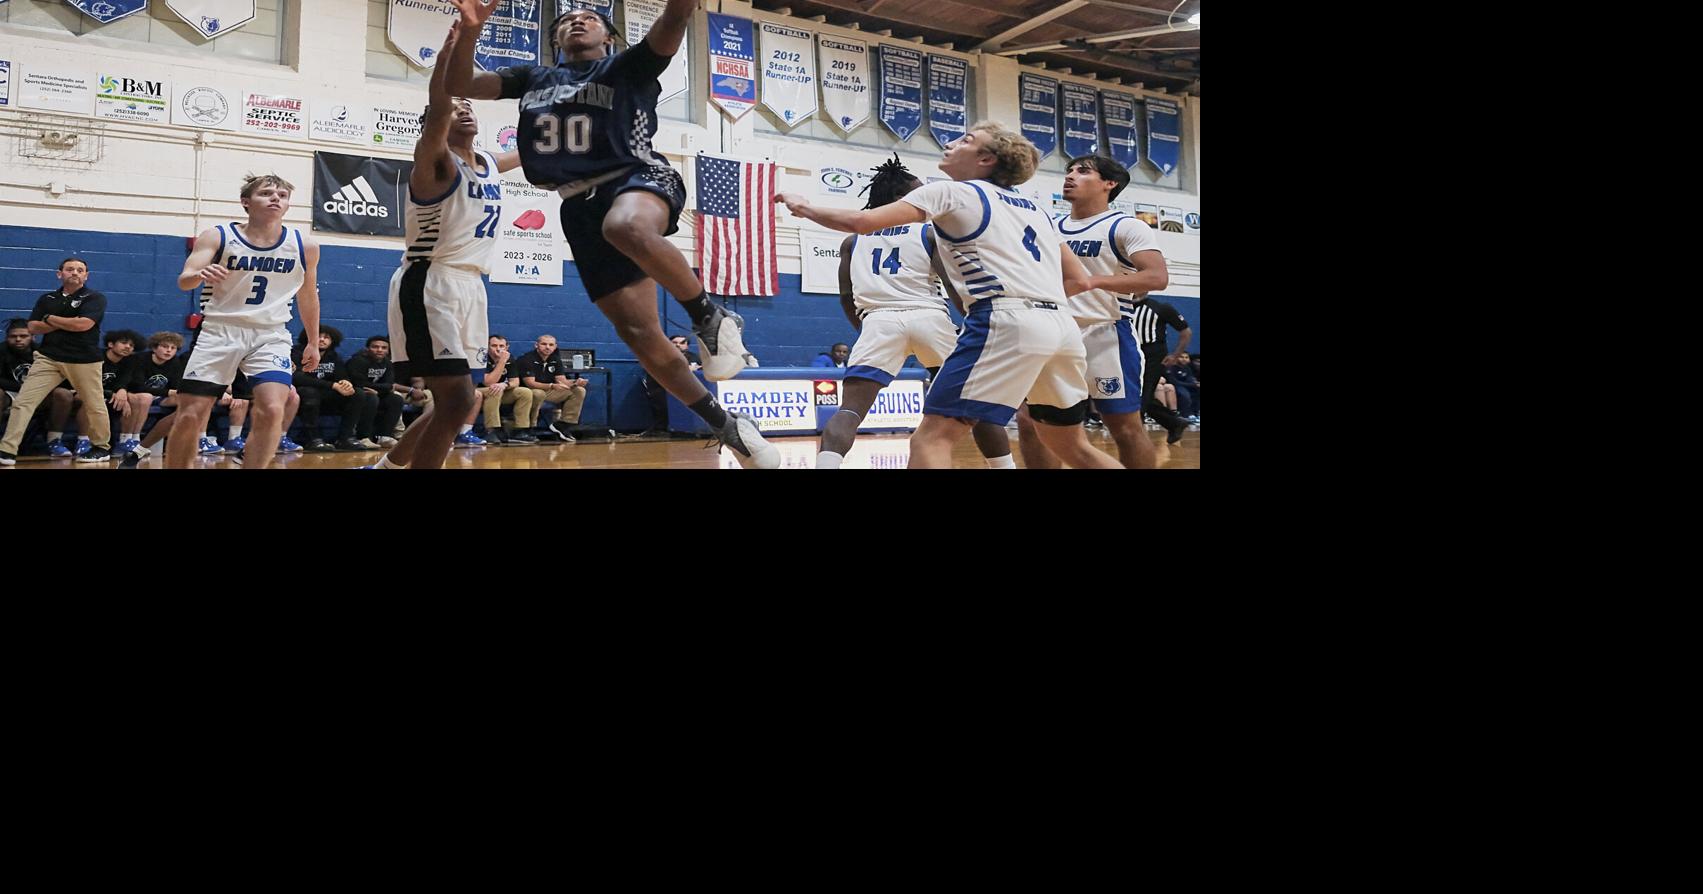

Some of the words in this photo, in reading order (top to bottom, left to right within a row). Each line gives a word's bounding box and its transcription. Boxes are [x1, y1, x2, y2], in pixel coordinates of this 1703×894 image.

[395, 0, 460, 16] Runner-UP
[764, 25, 808, 39] SOFTBALL
[723, 41, 741, 50] 2021
[822, 40, 864, 53] SOFTBALL
[773, 50, 801, 62] 2012
[884, 48, 919, 58] SOFTBALL
[716, 61, 750, 78] NCHSAA
[768, 62, 793, 72] State
[795, 66, 806, 74] 1A
[832, 60, 856, 72] 2019
[766, 70, 812, 84] Runner-UP
[826, 72, 849, 82] State
[851, 76, 861, 84] 1A
[121, 78, 163, 96] B&M
[822, 80, 866, 92] Runner-UP
[246, 94, 302, 110] ALBEMARLE
[246, 112, 300, 124] SERVICE
[252, 108, 296, 118] SEPTIC
[246, 119, 300, 130] 252-202-9969
[312, 120, 366, 130] ALBEMARLE
[380, 112, 420, 128] Harvey
[376, 122, 422, 136] Gregory
[533, 113, 592, 154] 30
[500, 180, 529, 189] Camden
[506, 188, 522, 196] High
[523, 190, 549, 198] School
[323, 199, 388, 218] adidas
[1022, 224, 1040, 262] 4
[504, 250, 524, 260] 2023
[532, 252, 552, 262] 2026
[812, 246, 840, 258] Senta
[226, 256, 296, 274] CAMDEN
[872, 247, 902, 276] 14
[244, 275, 268, 306] 3
[723, 392, 809, 404] CAMDEN
[816, 394, 837, 405] POSS
